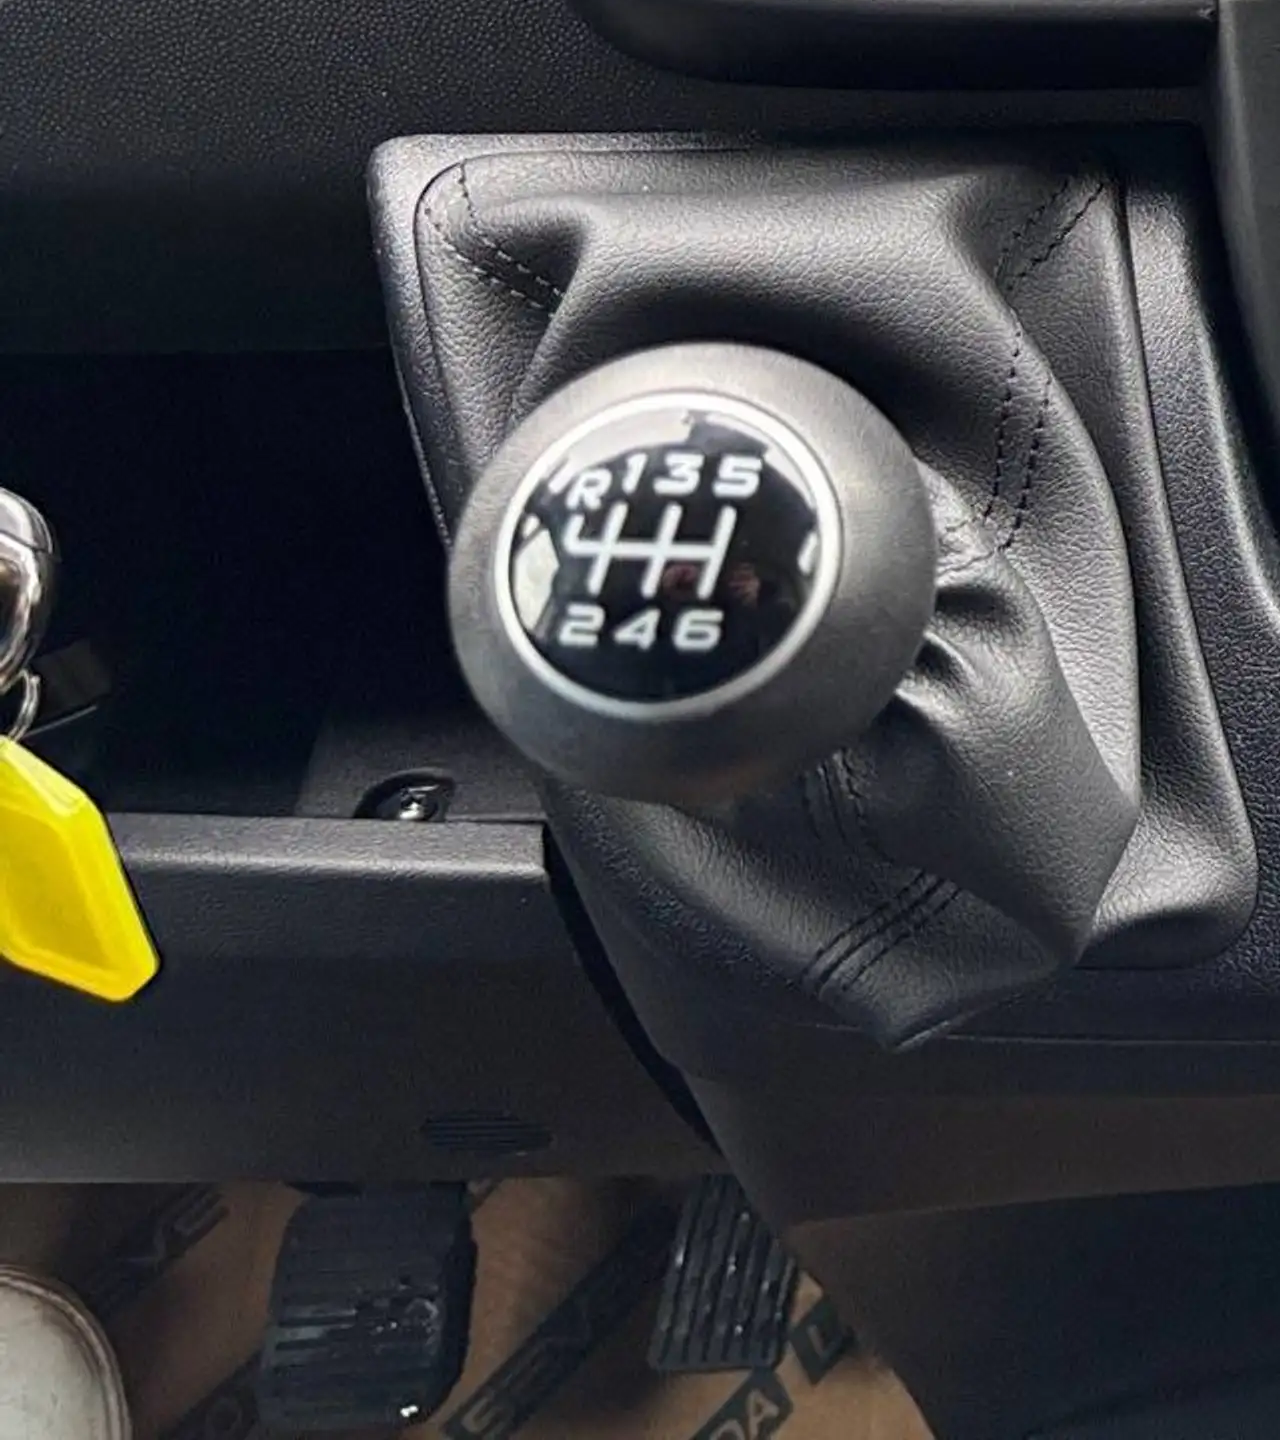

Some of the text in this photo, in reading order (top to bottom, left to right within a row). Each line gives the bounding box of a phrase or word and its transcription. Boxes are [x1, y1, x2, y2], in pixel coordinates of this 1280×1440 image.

[567, 469, 611, 509] R
[654, 455, 703, 496] 3
[713, 456, 762, 498] 5
[559, 605, 723, 650] 2 4 6
